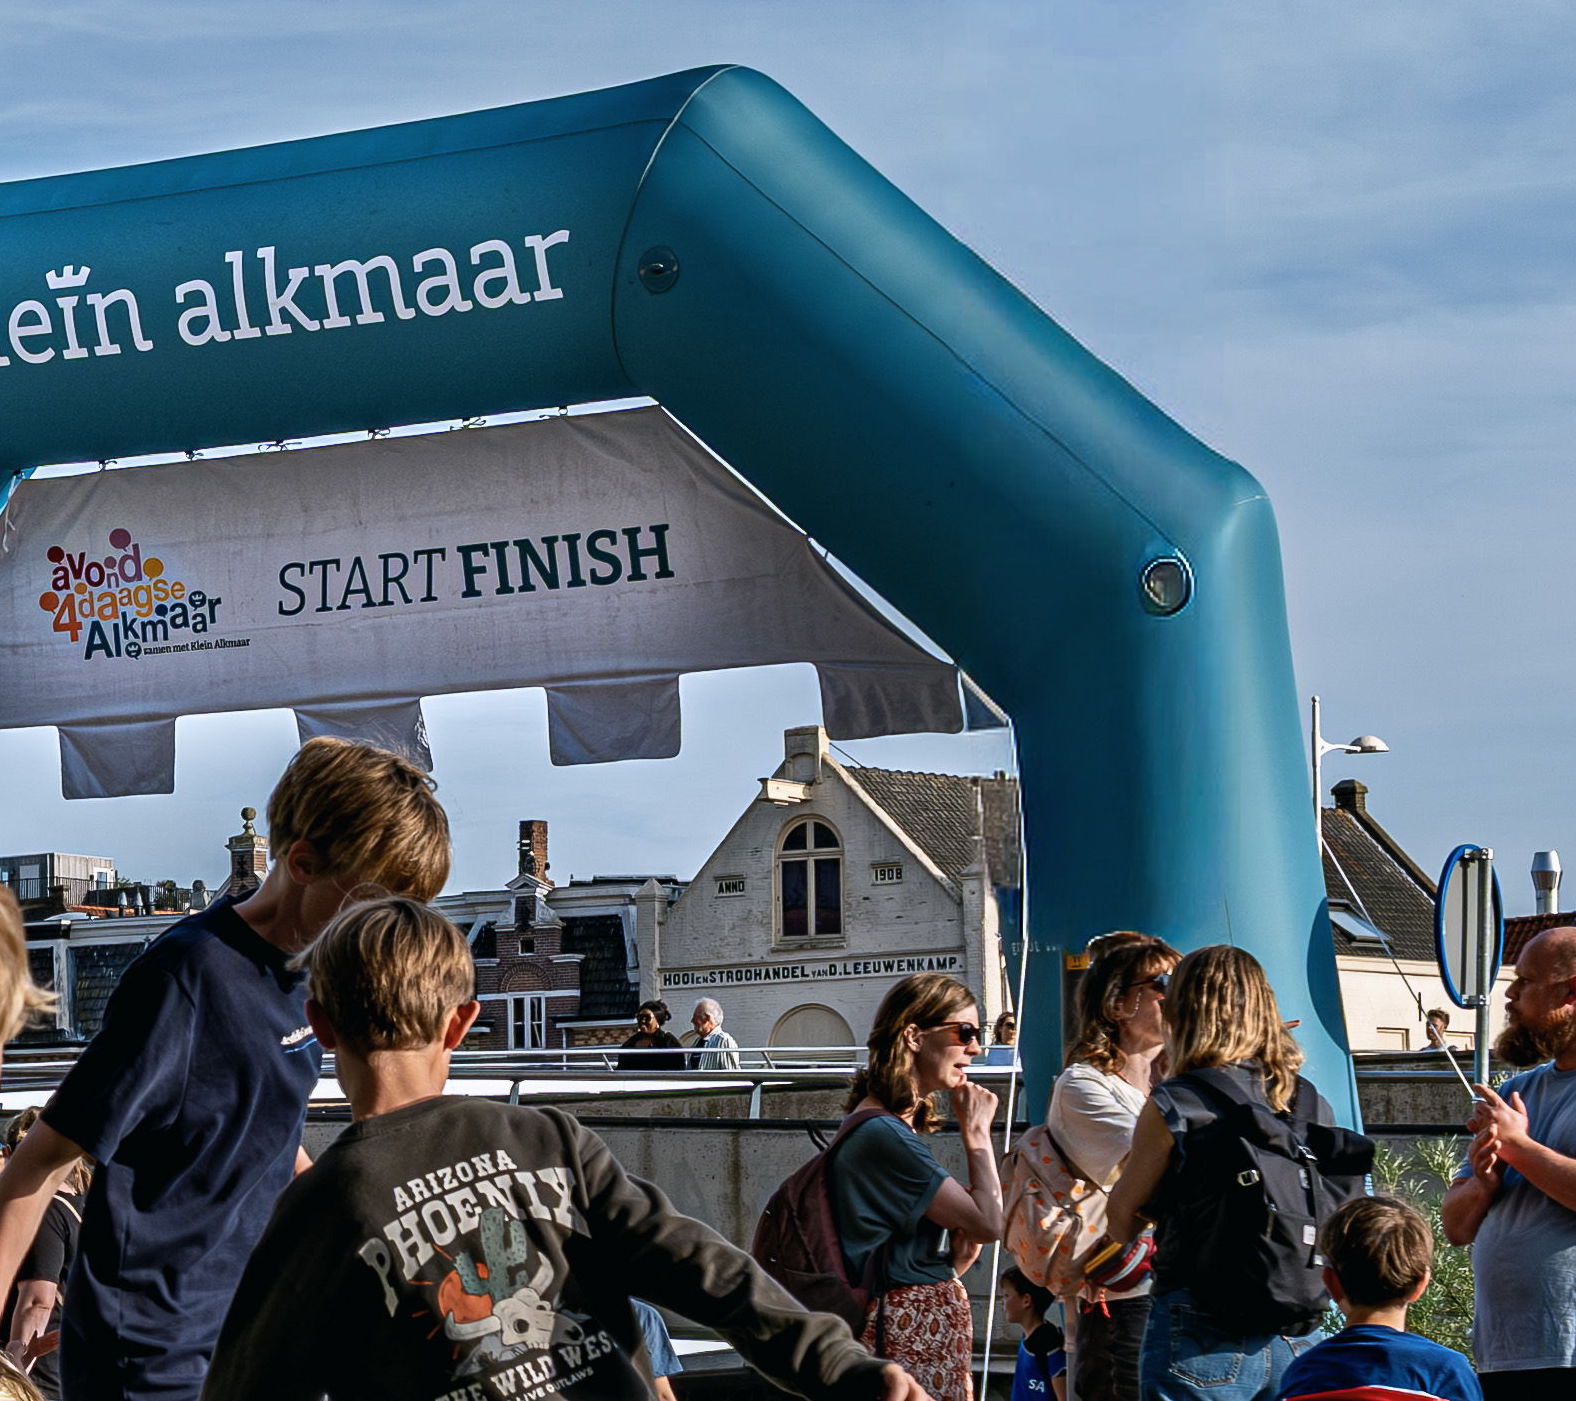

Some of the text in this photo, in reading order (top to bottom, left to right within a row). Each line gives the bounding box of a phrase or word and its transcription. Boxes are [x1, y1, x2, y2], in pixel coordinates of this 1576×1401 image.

[175, 229, 570, 345] alkmaar
[52, 543, 143, 591] avond
[277, 523, 676, 616] START FINISH
[53, 578, 186, 643] 4daagse
[84, 597, 222, 660] Alkmaar
[144, 638, 251, 655] samen met Klein Alkmaar
[717, 880, 745, 895] ANNO
[874, 867, 903, 882] 1908
[663, 972, 695, 986] HOOI
[709, 964, 810, 984] STROOHANDEL
[393, 1149, 517, 1212] ARIZONA
[491, 1355, 557, 1397] WILD
[558, 1331, 619, 1370] WES
[546, 1367, 594, 1394] OUTLAWS
